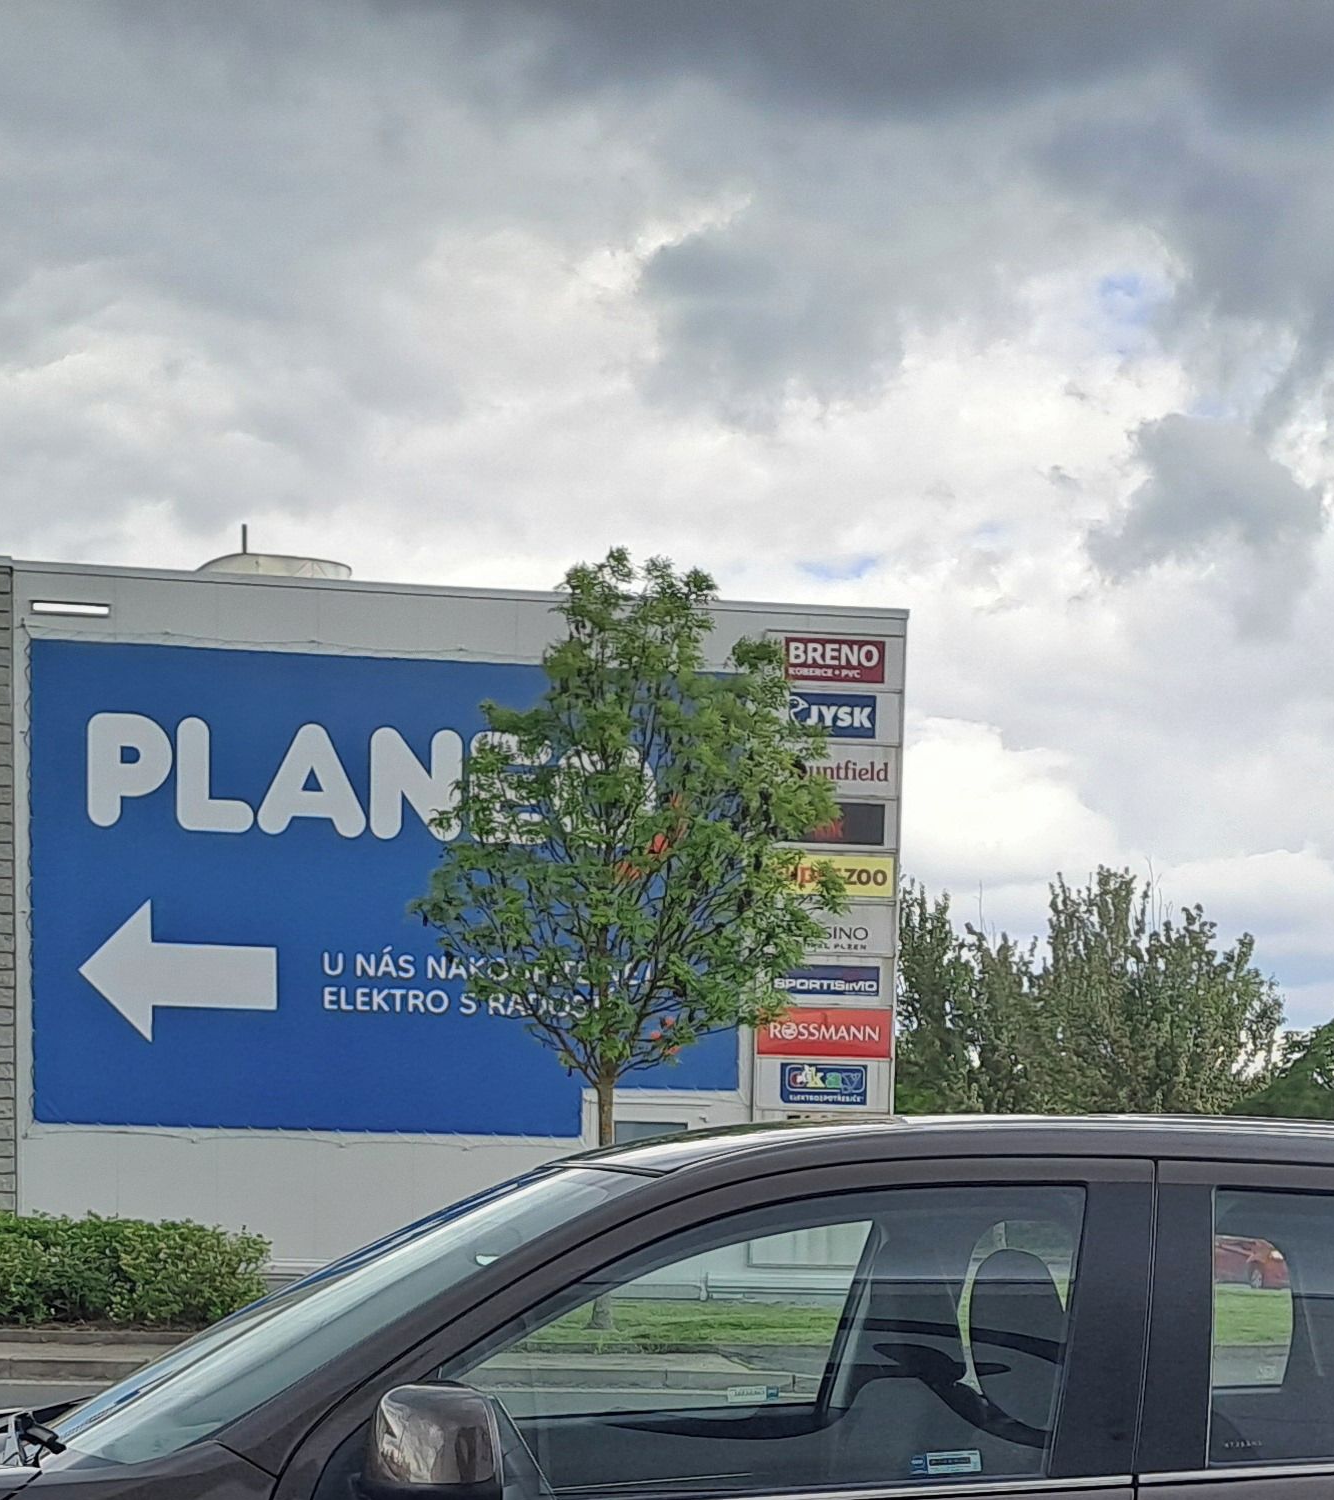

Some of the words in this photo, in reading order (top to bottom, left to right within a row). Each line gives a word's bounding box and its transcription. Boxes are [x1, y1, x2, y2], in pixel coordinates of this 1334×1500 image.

[789, 642, 879, 667] BRENO
[841, 669, 861, 678] PVC
[807, 705, 873, 728] JYSK
[794, 759, 890, 782] untfield
[821, 926, 869, 941] SINO
[323, 952, 344, 976] U
[356, 945, 416, 978] NÁS
[774, 978, 877, 992] SPORTISIMO
[323, 987, 449, 1014] ELEKTRO
[459, 993, 477, 1015] S
[770, 1022, 880, 1041] ROSSMANN
